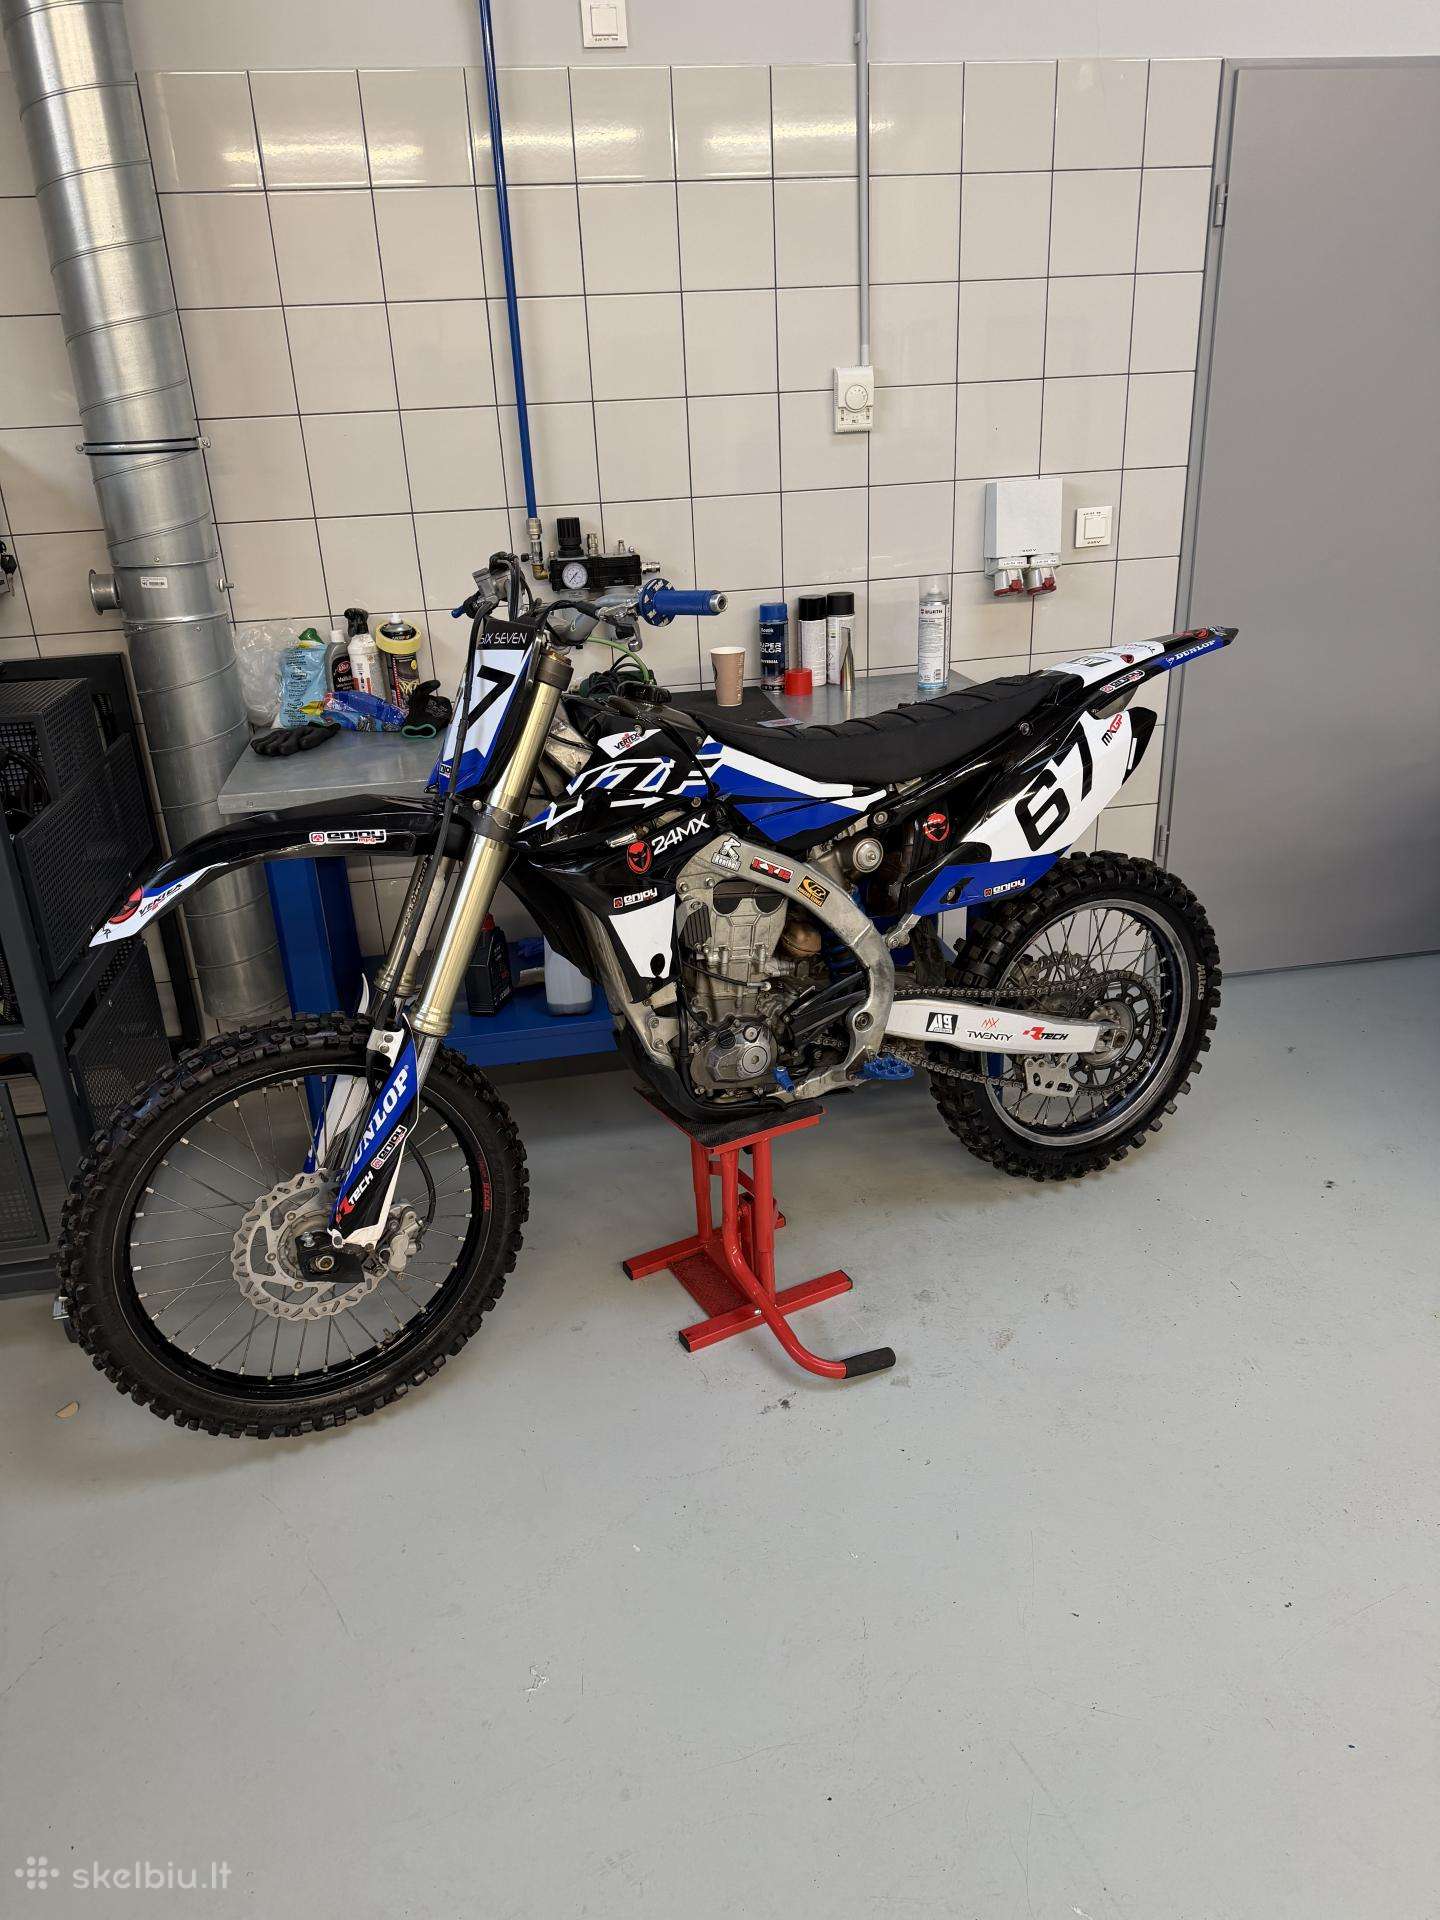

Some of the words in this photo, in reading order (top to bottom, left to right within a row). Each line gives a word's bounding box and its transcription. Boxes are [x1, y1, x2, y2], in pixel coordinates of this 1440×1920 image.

[494, 632, 528, 645] SEVEN
[1174, 639, 1216, 660] DUNLOP
[1014, 720, 1094, 852] 67
[326, 831, 385, 842] enjoy
[651, 813, 710, 857] 24MX
[992, 878, 1026, 895] enjoy
[623, 887, 658, 907] enjoy
[967, 1030, 1014, 1042] TWENTY
[378, 1128, 406, 1160] enjoy
